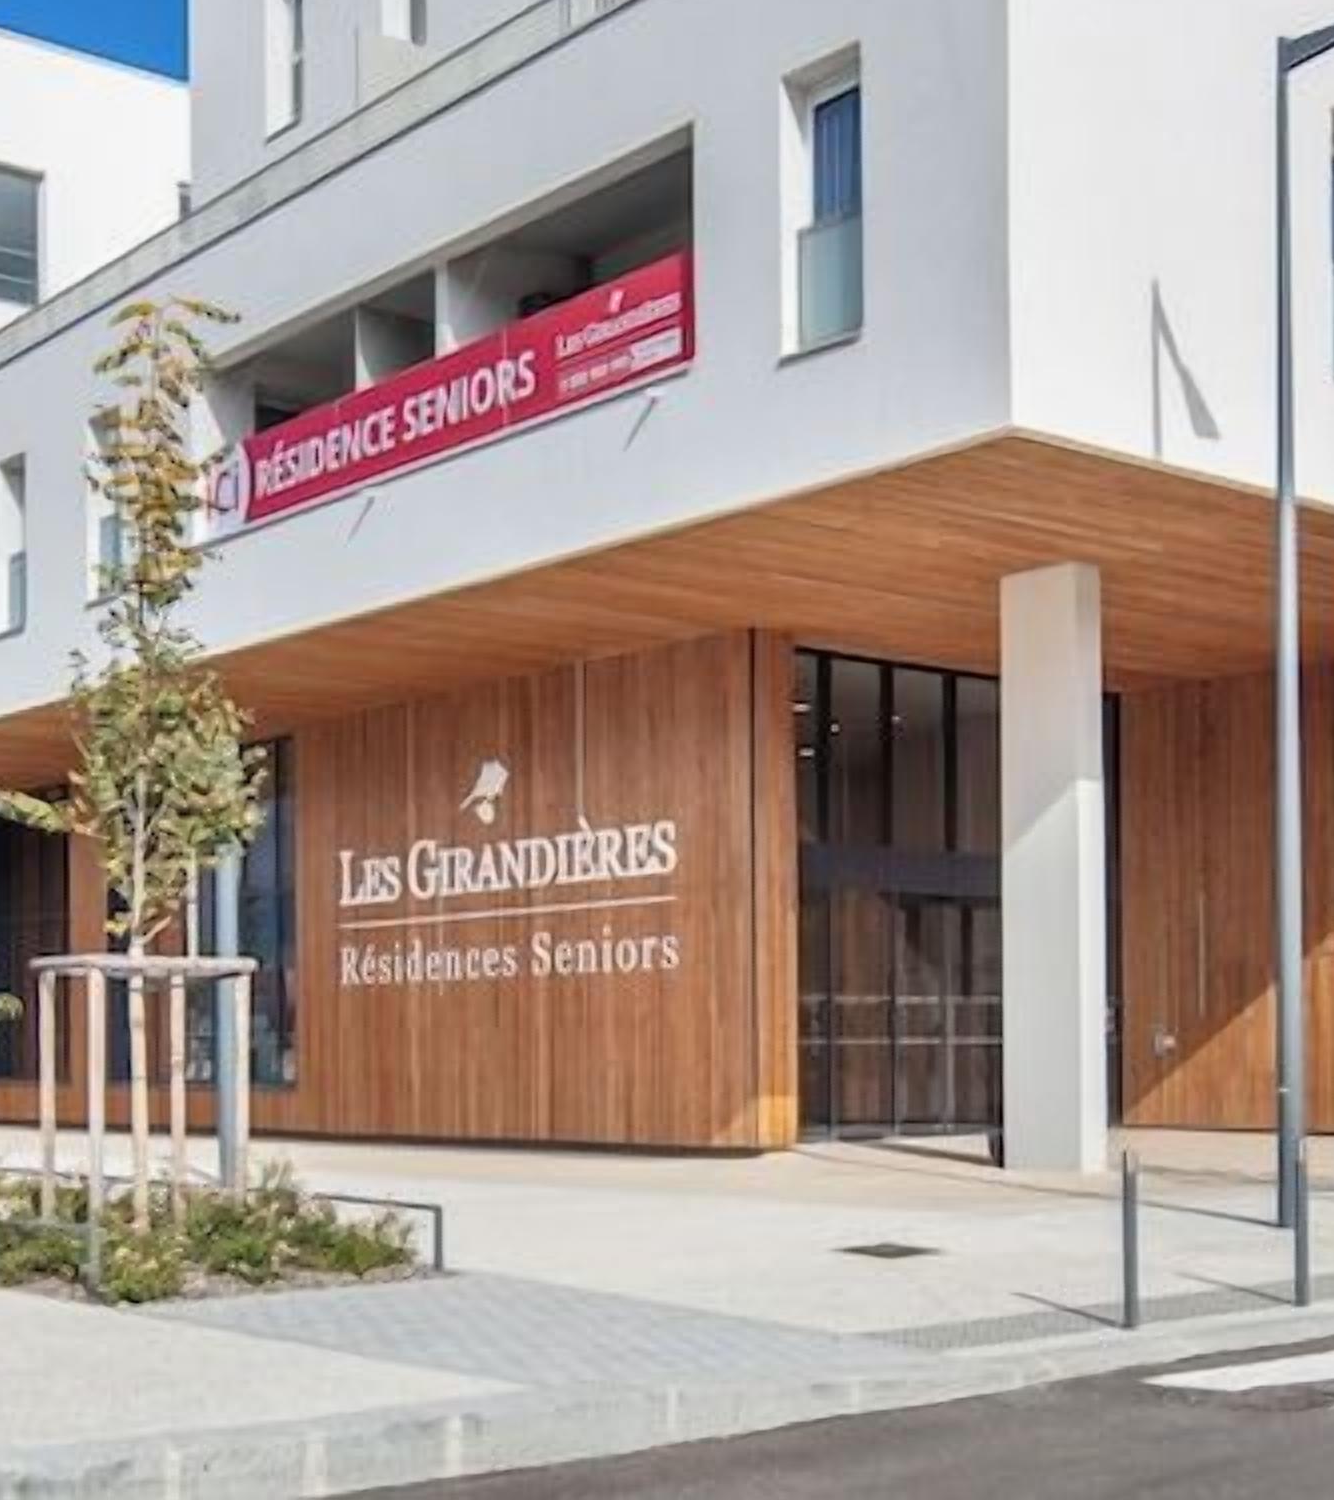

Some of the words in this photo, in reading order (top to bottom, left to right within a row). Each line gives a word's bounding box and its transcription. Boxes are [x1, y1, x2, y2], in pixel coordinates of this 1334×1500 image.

[255, 405, 397, 499] RÉSIDENCE
[402, 350, 536, 441] SENIORS
[339, 849, 403, 907] LES
[407, 814, 678, 900] GIRANDIÈRES
[340, 934, 519, 986] Résidences
[530, 924, 680, 978] Seniors
